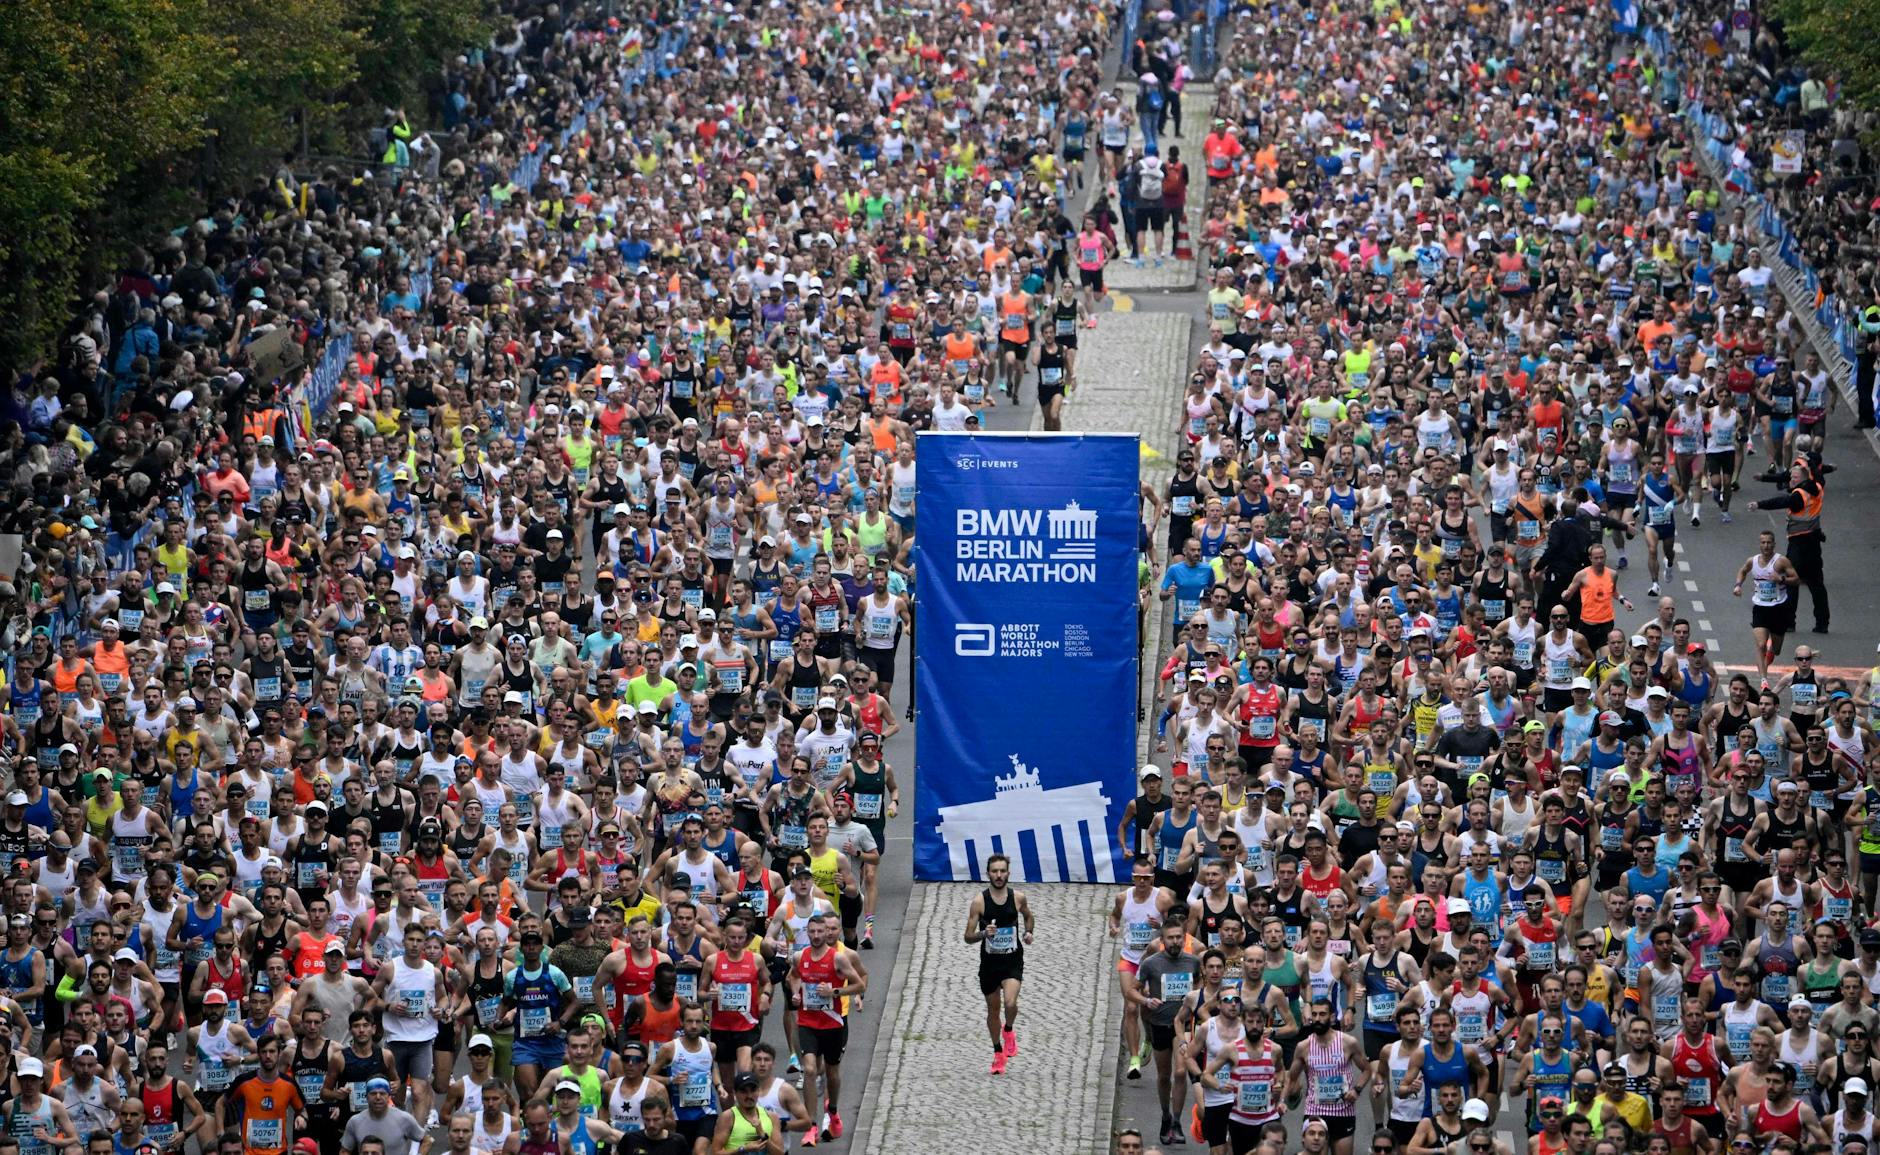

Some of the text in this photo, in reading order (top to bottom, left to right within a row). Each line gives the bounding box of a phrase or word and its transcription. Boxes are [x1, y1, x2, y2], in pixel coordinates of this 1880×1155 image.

[957, 458, 1018, 469] SCC EVENTS
[956, 509, 1042, 536] BMW
[956, 540, 1042, 559] BERLIN
[956, 563, 1096, 582] MARATHON
[1000, 624, 1040, 632] ABBOTT
[1000, 632, 1036, 640] WORLD
[1000, 641, 1059, 649] MARATHON
[1000, 649, 1043, 657] MAJORS
[253, 1129, 276, 1137] 50767
